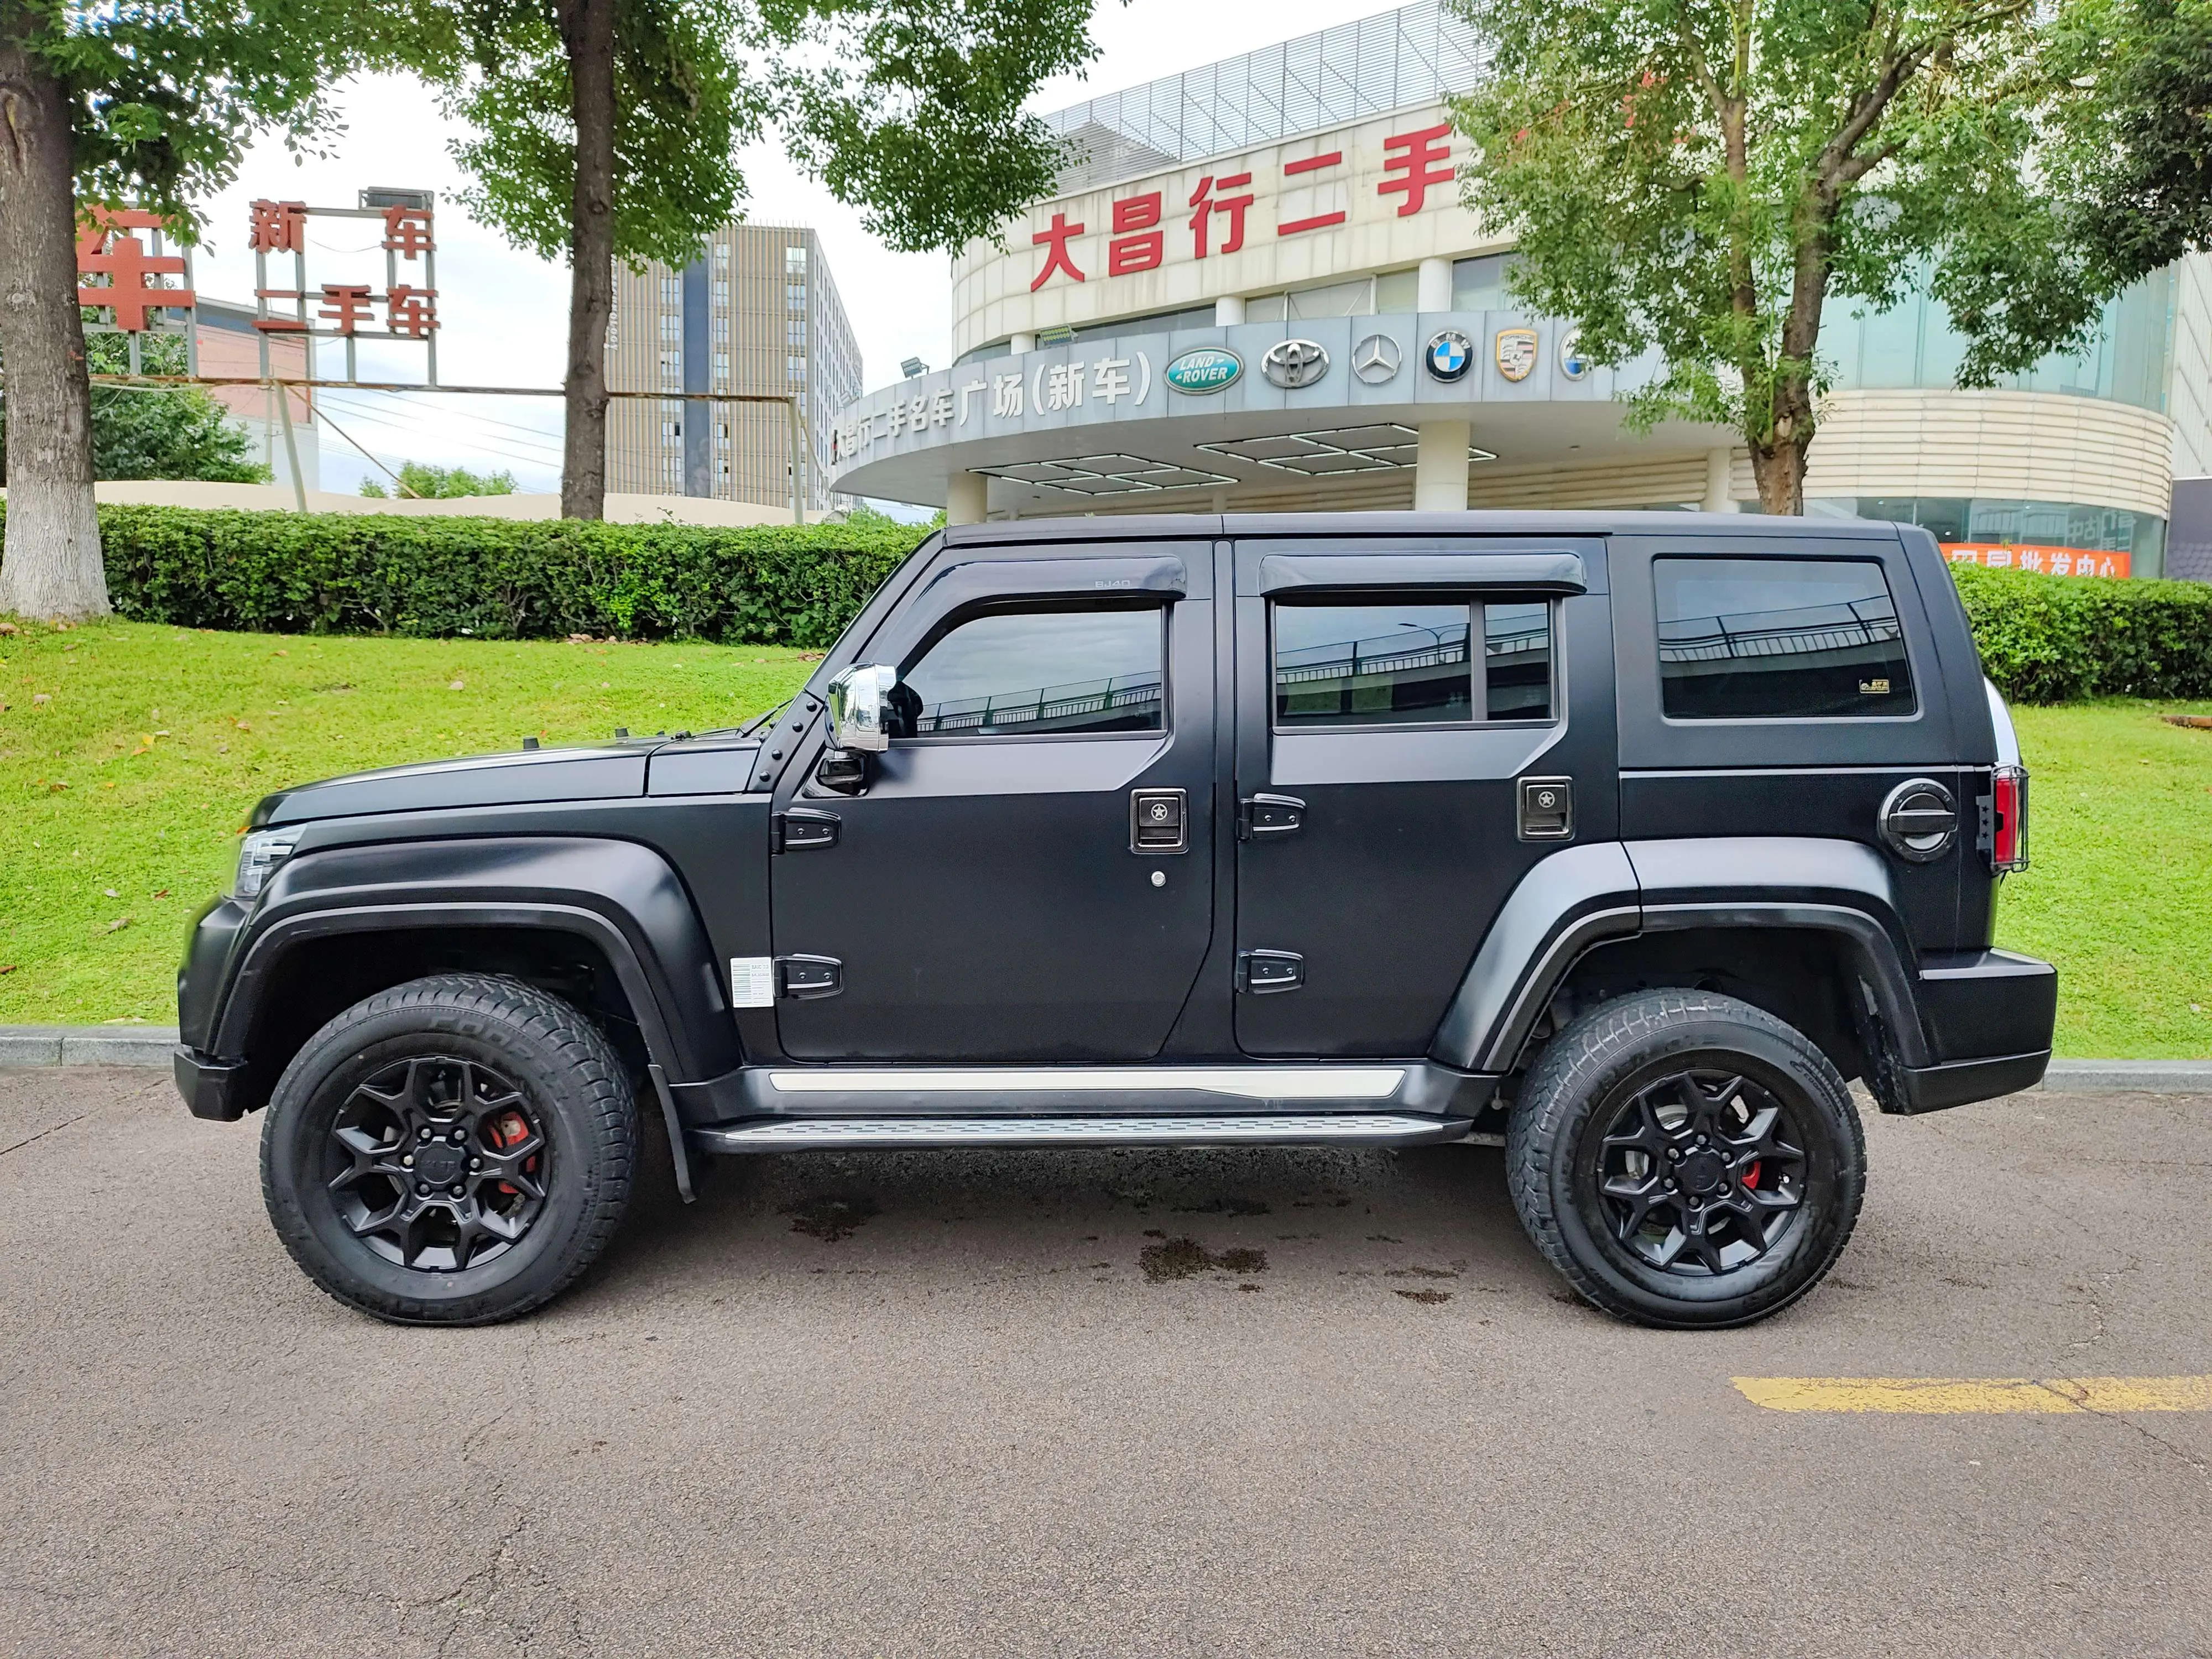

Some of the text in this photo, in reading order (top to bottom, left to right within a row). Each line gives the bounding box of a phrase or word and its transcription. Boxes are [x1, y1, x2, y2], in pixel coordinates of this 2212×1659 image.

[252, 284, 440, 337] 二手车
[1180, 356, 1213, 370] LAND
[1182, 366, 1228, 383] ROVER
[1095, 580, 1130, 588] BJ40
